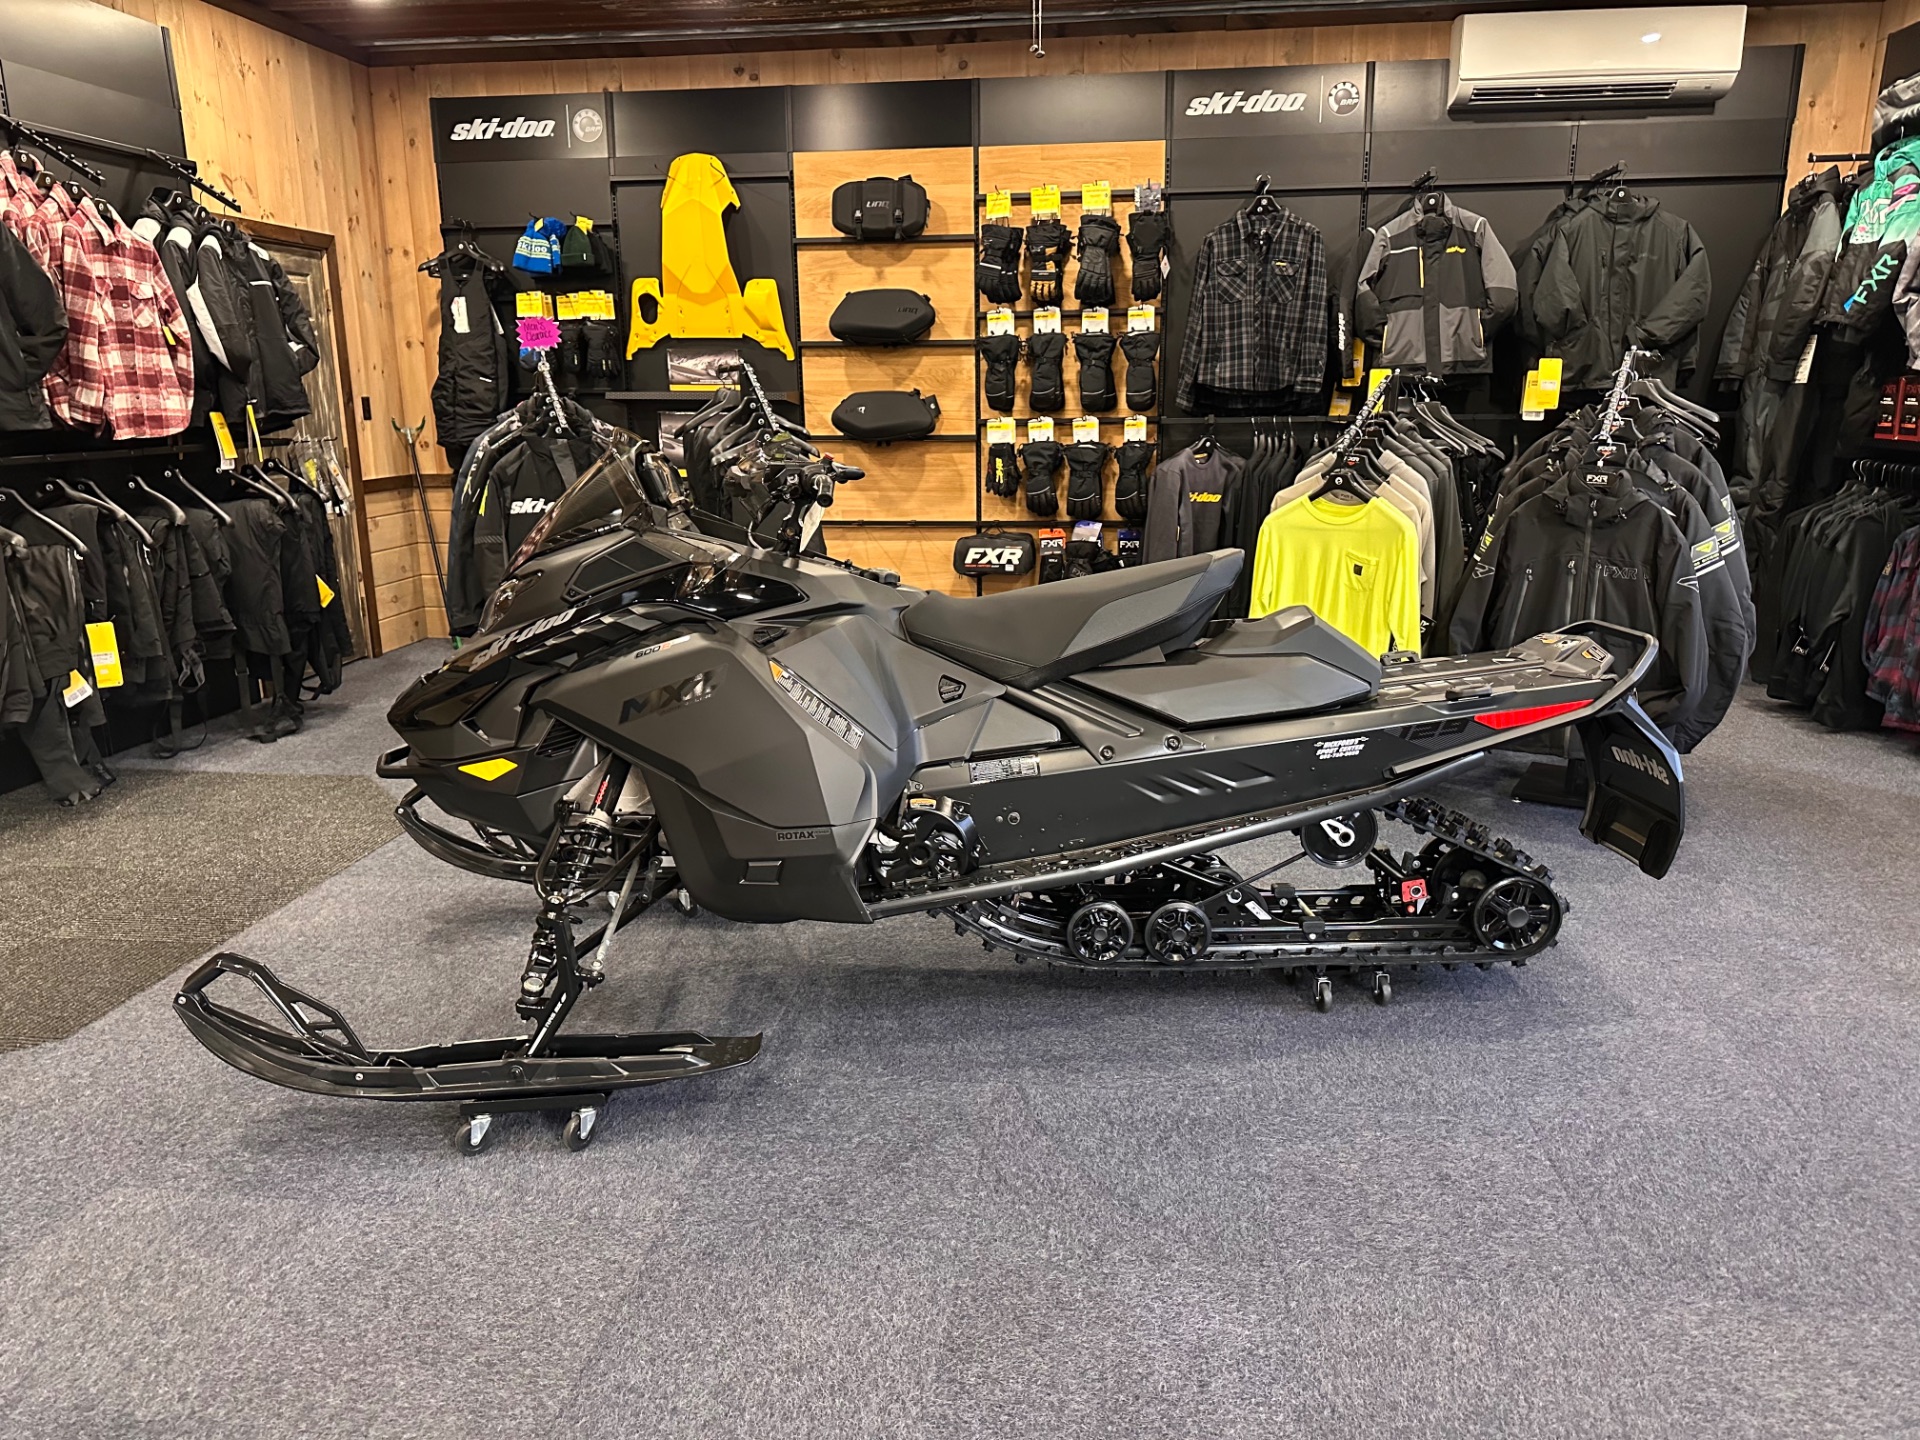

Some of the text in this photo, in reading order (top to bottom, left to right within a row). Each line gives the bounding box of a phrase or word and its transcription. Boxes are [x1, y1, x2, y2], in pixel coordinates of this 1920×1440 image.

[1185, 89, 1307, 116] ski-doo
[450, 116, 555, 141] ski-doo
[1844, 252, 1899, 313] FXR
[1587, 474, 1608, 483] FXR
[1041, 539, 1064, 548] FXR
[1120, 541, 1140, 549] FXR
[965, 548, 1023, 565] FXR
[1603, 565, 1638, 580] FXR
[777, 831, 815, 840] ROTAX
